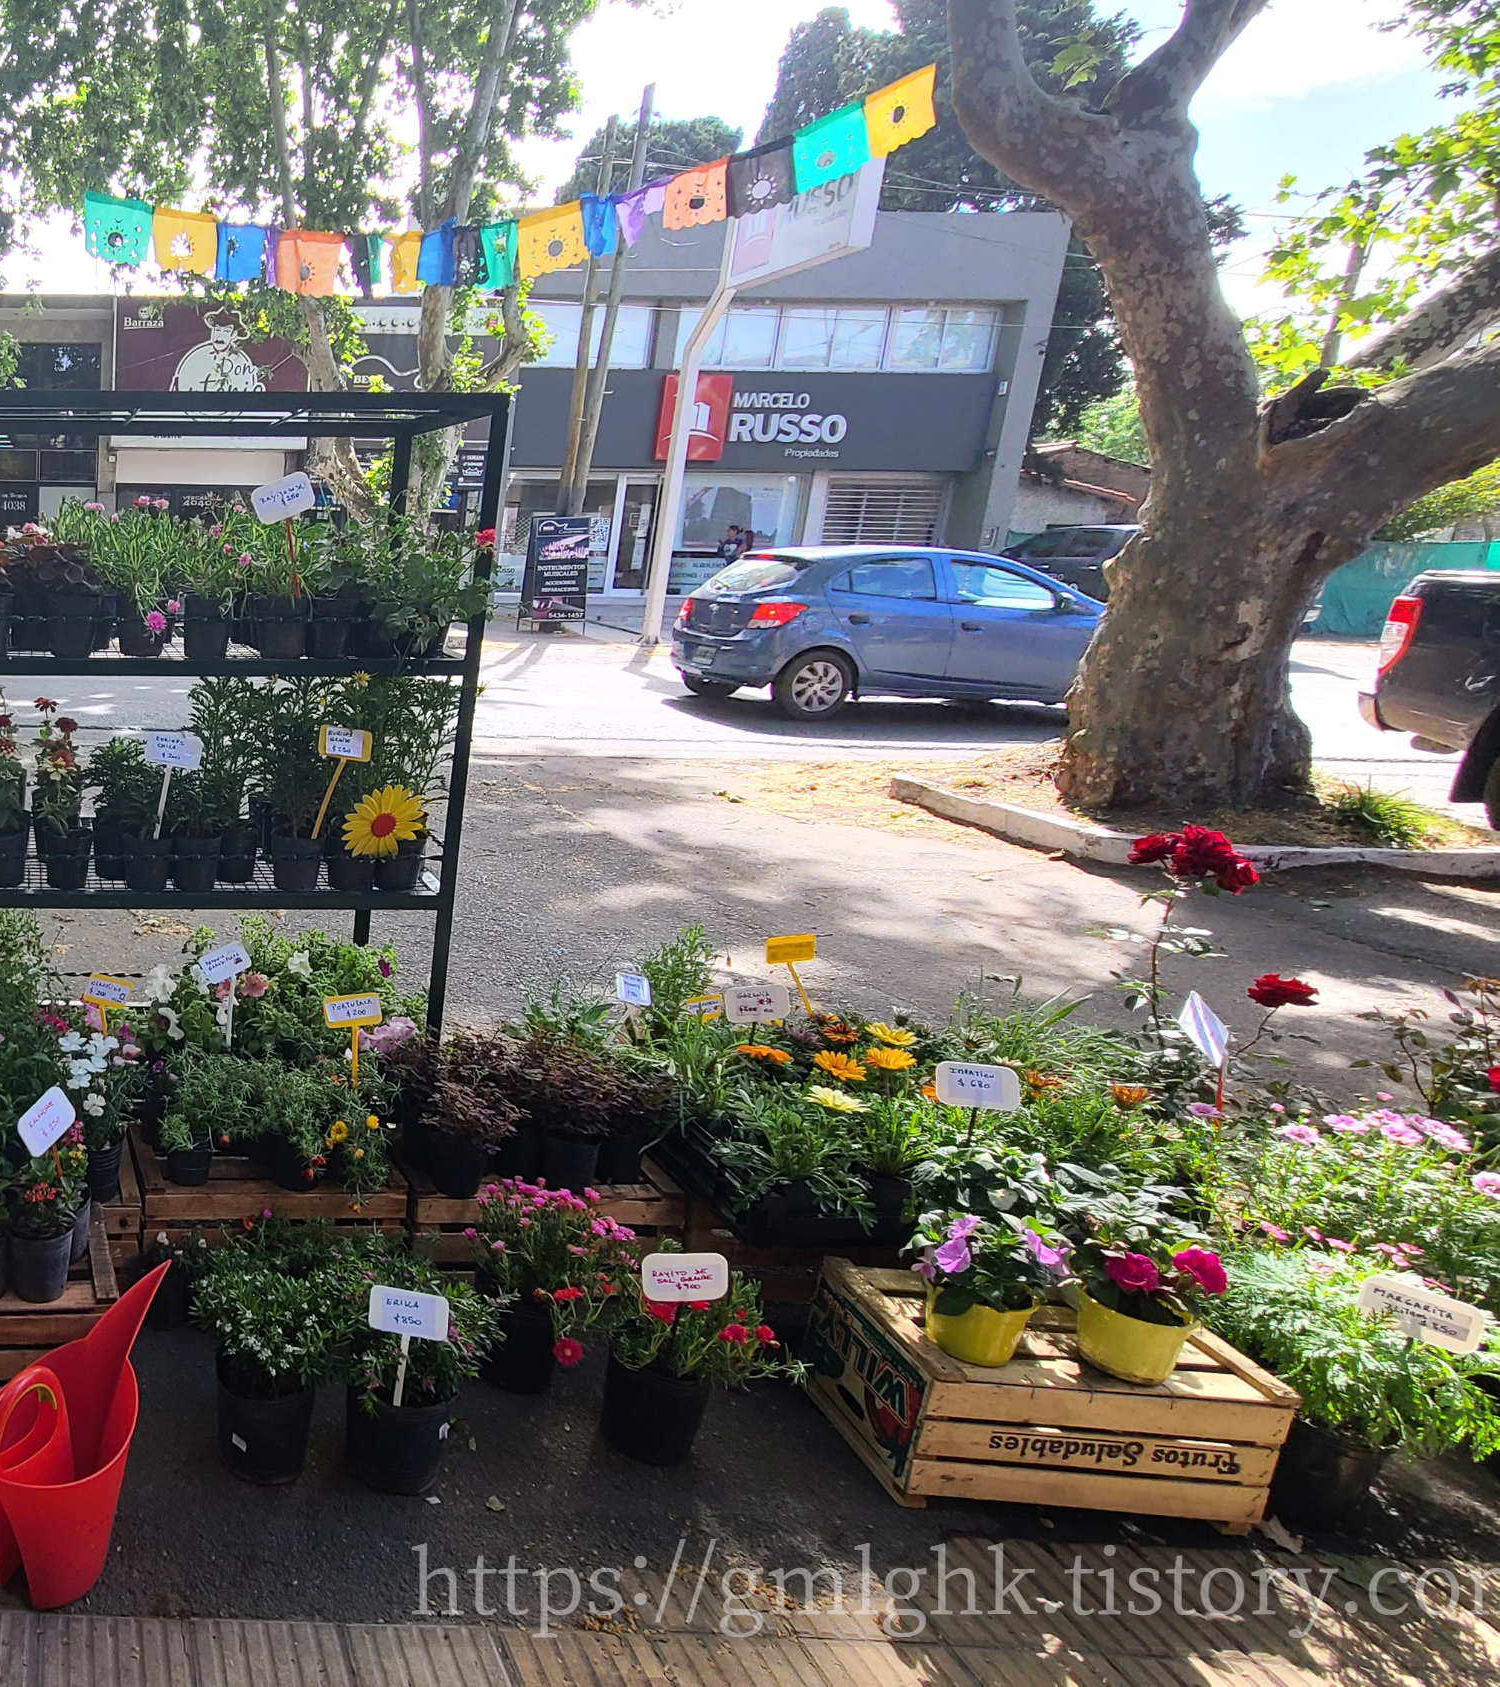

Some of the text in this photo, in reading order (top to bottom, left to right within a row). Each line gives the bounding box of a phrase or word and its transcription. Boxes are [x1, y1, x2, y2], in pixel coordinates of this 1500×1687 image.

[124, 316, 164, 328] Barraza
[221, 356, 256, 376] Don
[732, 392, 810, 408] MARCELO
[728, 412, 847, 444] RUSSO
[785, 448, 839, 459] Propiedades
[1, 501, 26, 511] 4038
[970, 1080, 991, 1088] 680
[651, 1270, 687, 1278] RAYITO
[386, 1298, 419, 1308] ERIKA
[1373, 1287, 1454, 1320] MARGARITA
[815, 1312, 910, 1428] WILLY
[989, 1434, 1241, 1475] Frutos Saludables
